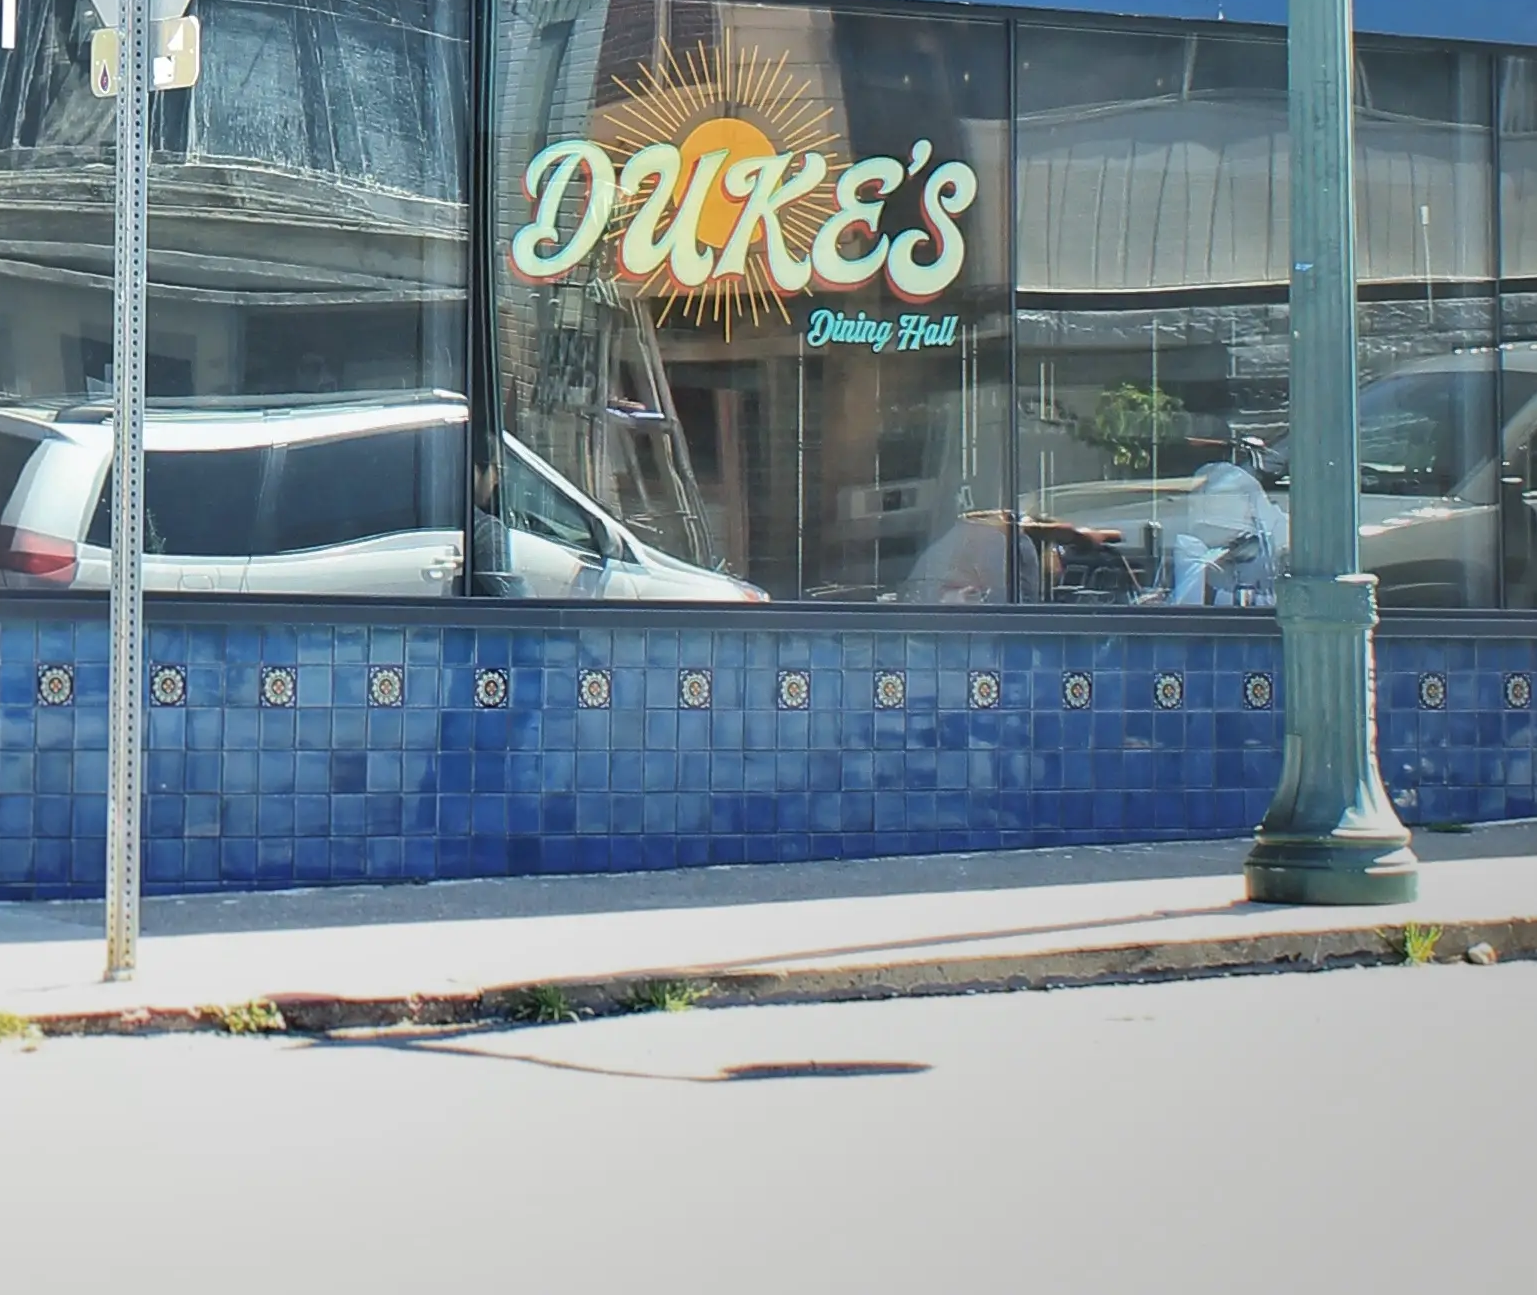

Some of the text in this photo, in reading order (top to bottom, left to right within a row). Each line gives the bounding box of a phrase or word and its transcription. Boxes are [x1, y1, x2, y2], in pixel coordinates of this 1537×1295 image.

[508, 138, 978, 303] DUKE'S
[807, 309, 959, 353] Dining Hall
